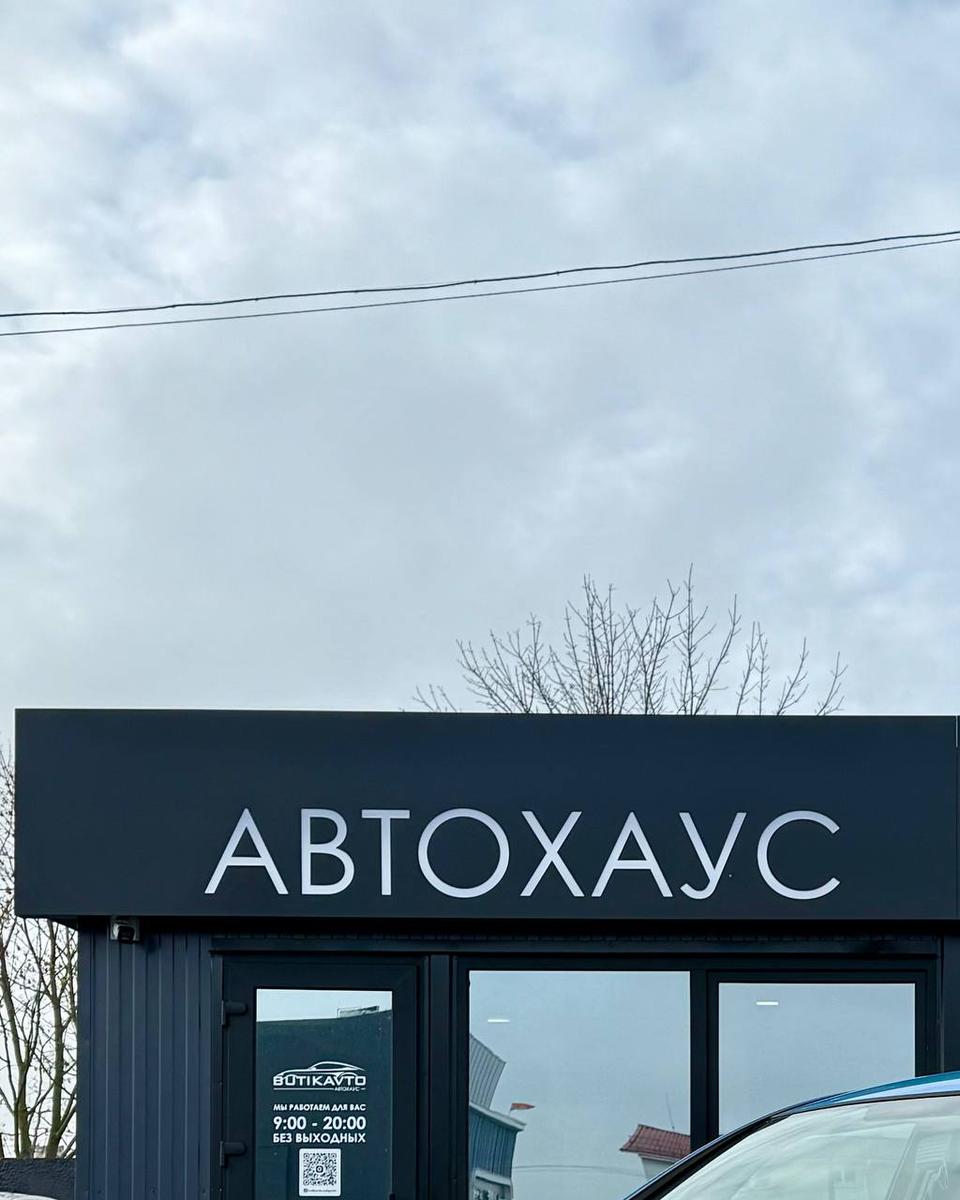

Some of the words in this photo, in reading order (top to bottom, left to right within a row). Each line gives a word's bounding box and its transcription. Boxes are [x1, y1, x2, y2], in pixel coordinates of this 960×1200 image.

[204, 808, 841, 900] АВТОХАУС
[273, 1075, 366, 1086] BUTIKAVTO
[331, 1104, 348, 1112] ДЛЯ
[273, 1116, 307, 1130] 9:00
[323, 1116, 366, 1130] 20:00
[273, 1133, 292, 1143] БЕЗ
[295, 1133, 366, 1144] ВЫХОДНЫХ
